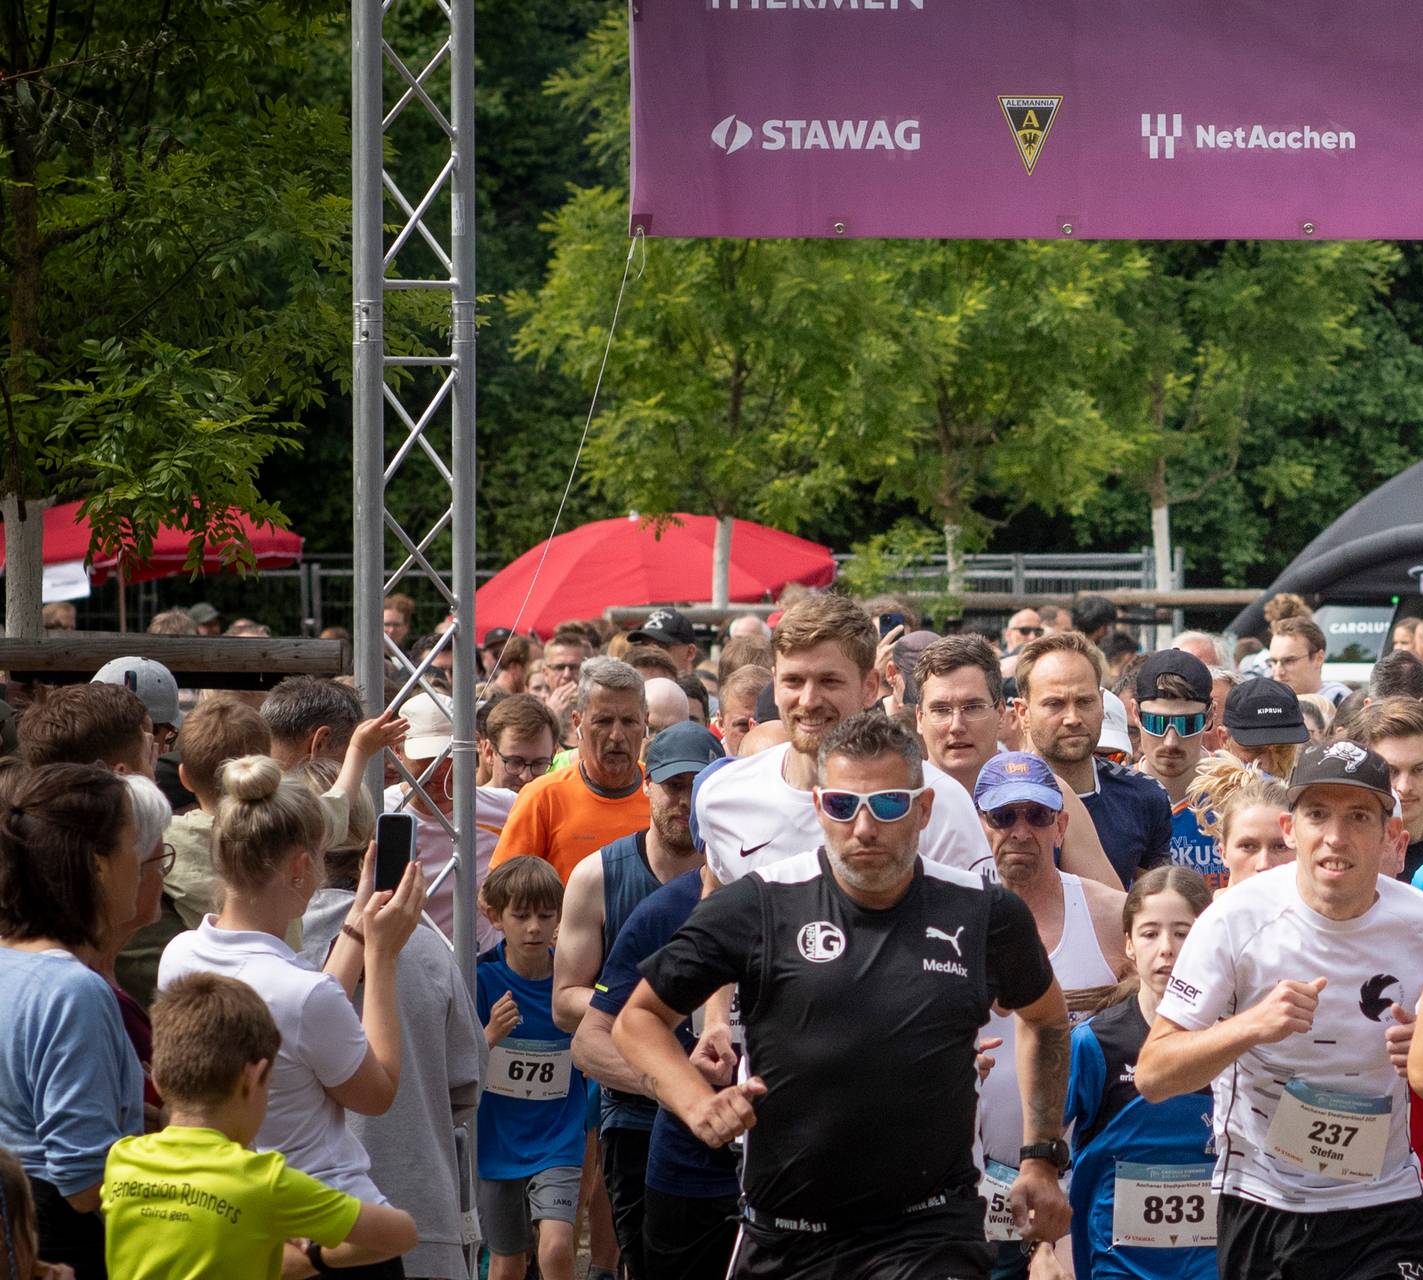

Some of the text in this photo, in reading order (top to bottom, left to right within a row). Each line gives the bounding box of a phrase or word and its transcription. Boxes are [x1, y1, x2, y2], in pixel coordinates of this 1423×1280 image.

[1006, 99, 1055, 107] ALEMANNIA
[1022, 109, 1039, 128] A
[762, 120, 921, 150] STAWAG
[1196, 124, 1356, 149] NetAachen
[922, 958, 968, 977] MedAix
[508, 1060, 555, 1083] 678
[1307, 1120, 1359, 1147] 237
[1309, 1145, 1344, 1161] Stefan
[140, 1206, 192, 1222] third gen.
[180, 1182, 242, 1224] Runners
[1143, 1194, 1205, 1224] 833
